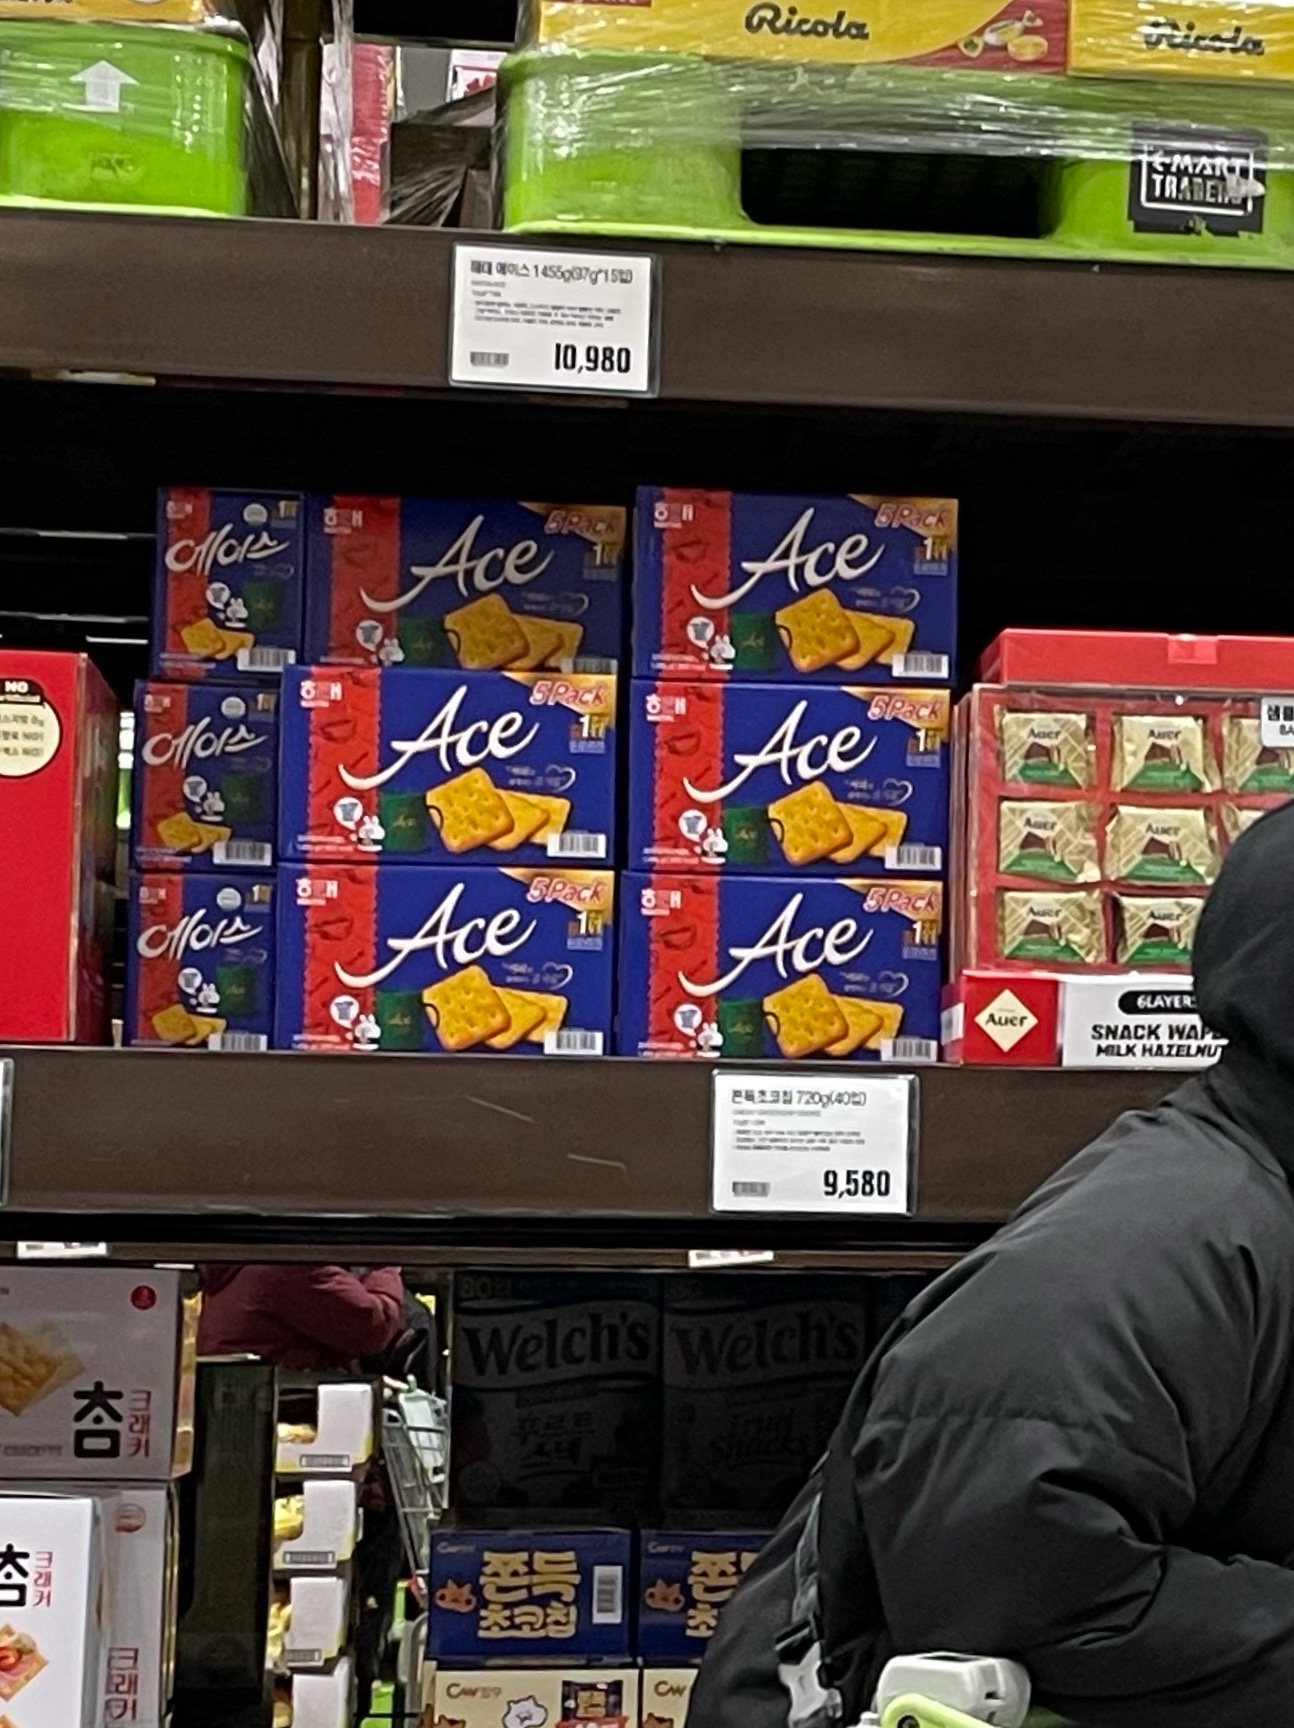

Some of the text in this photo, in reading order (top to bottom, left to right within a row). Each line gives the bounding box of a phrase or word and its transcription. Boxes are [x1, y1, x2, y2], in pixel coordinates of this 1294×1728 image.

[744, 1, 870, 42] Ricola
[1138, 18, 1266, 57] Ricola
[554, 342, 632, 375] 10,980
[359, 514, 556, 613] Ace
[690, 507, 886, 610] Ace
[338, 685, 541, 790] Ace
[683, 700, 878, 803] Ace
[335, 883, 537, 989] Ace
[678, 893, 875, 997] Ace
[984, 1012, 1029, 1029] Auer
[1091, 1023, 1164, 1041] SNACK
[1096, 1043, 1138, 1059] MILK
[823, 1169, 891, 1199] 9,580
[461, 1312, 651, 1377] Welch's
[670, 1312, 859, 1377] Welch's
